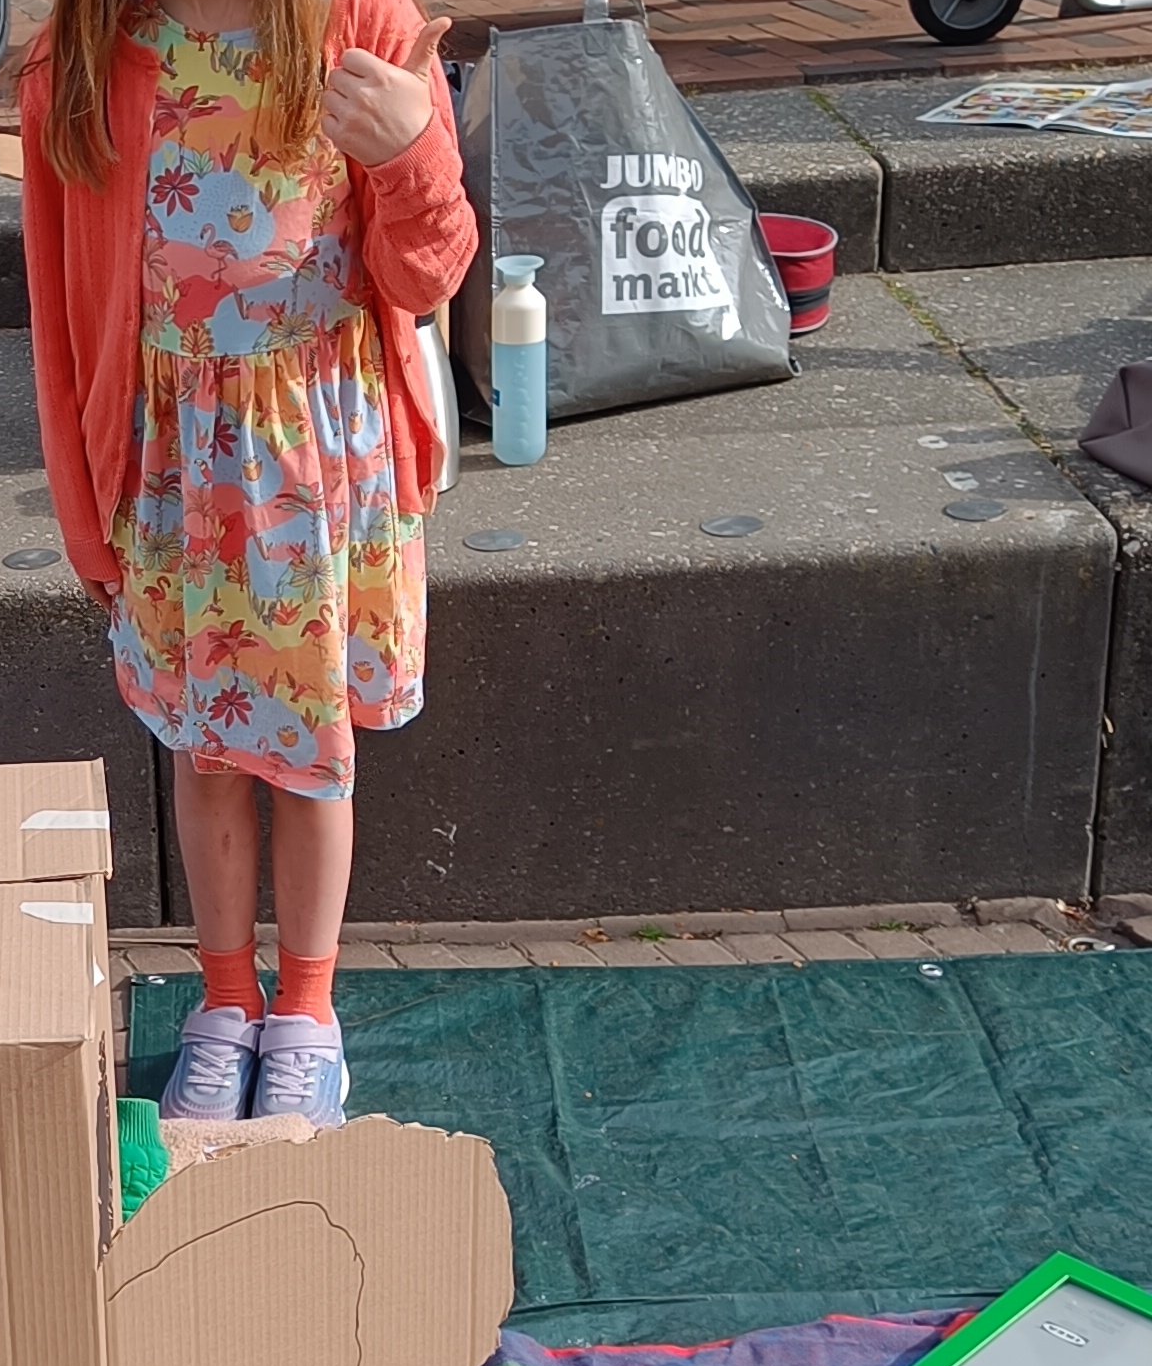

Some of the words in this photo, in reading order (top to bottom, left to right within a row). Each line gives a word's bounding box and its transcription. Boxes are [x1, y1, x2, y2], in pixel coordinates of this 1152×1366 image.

[600, 154, 703, 192] JUMBO
[610, 207, 705, 259] food
[612, 264, 720, 301] markt
